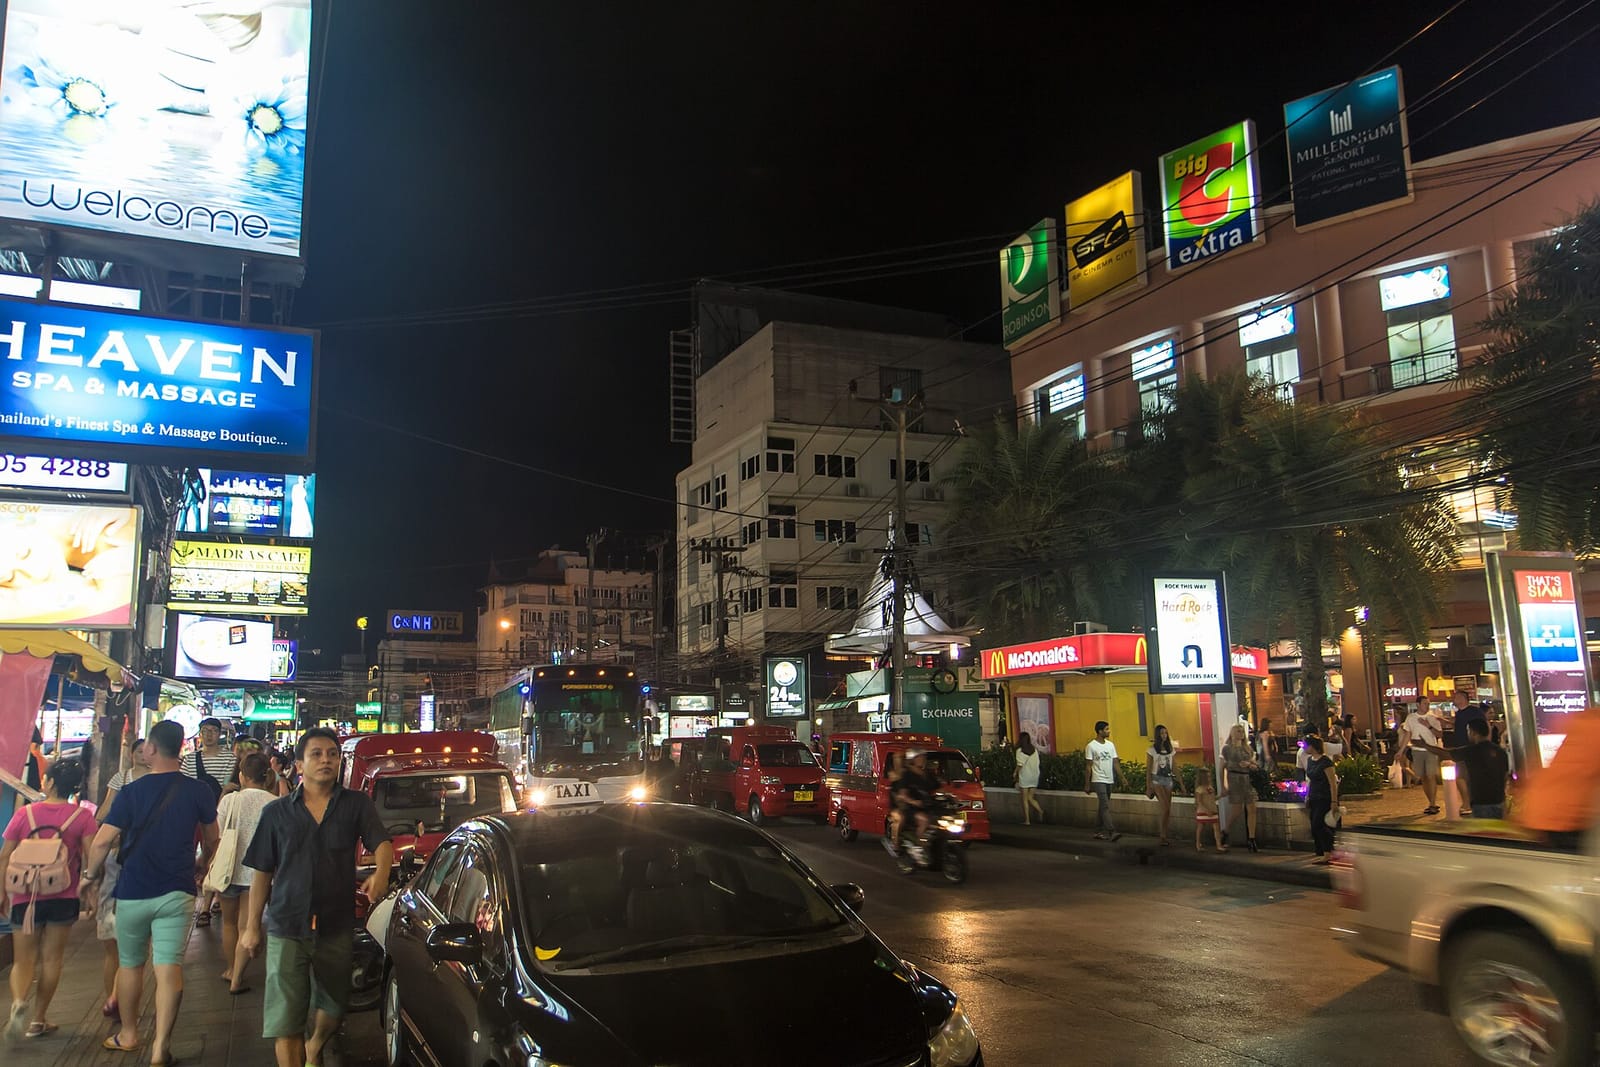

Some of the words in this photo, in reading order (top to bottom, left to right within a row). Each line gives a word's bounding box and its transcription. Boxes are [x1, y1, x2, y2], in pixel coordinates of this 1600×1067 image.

[1296, 122, 1394, 163] MILLENNIUM
[1174, 154, 1208, 180] Big
[1324, 146, 1365, 167] RESORT
[22, 180, 269, 239] welcome
[1178, 227, 1243, 264] extra
[1083, 258, 1113, 275] CINEMA
[1115, 248, 1134, 262] CITY
[1003, 303, 1050, 337] ROBINSON
[0, 320, 297, 387] HEAVEN
[12, 371, 77, 395] SPA
[84, 377, 105, 396] &
[117, 381, 257, 409] MASSAGE
[66, 416, 109, 432] Finest
[113, 420, 139, 436] Spa
[141, 422, 156, 435] &
[159, 423, 217, 442] Massage
[220, 428, 289, 446] Boutique...
[41, 457, 111, 478] 4288
[196, 546, 264, 561] MADRAS
[268, 551, 307, 563] CAFE
[1525, 574, 1561, 587] THAT'S
[1527, 584, 1563, 598] SIAM
[1161, 600, 1186, 612] Hard
[770, 686, 788, 702] 24
[922, 708, 974, 719] EXCHANGE
[553, 783, 592, 799] TAXI
